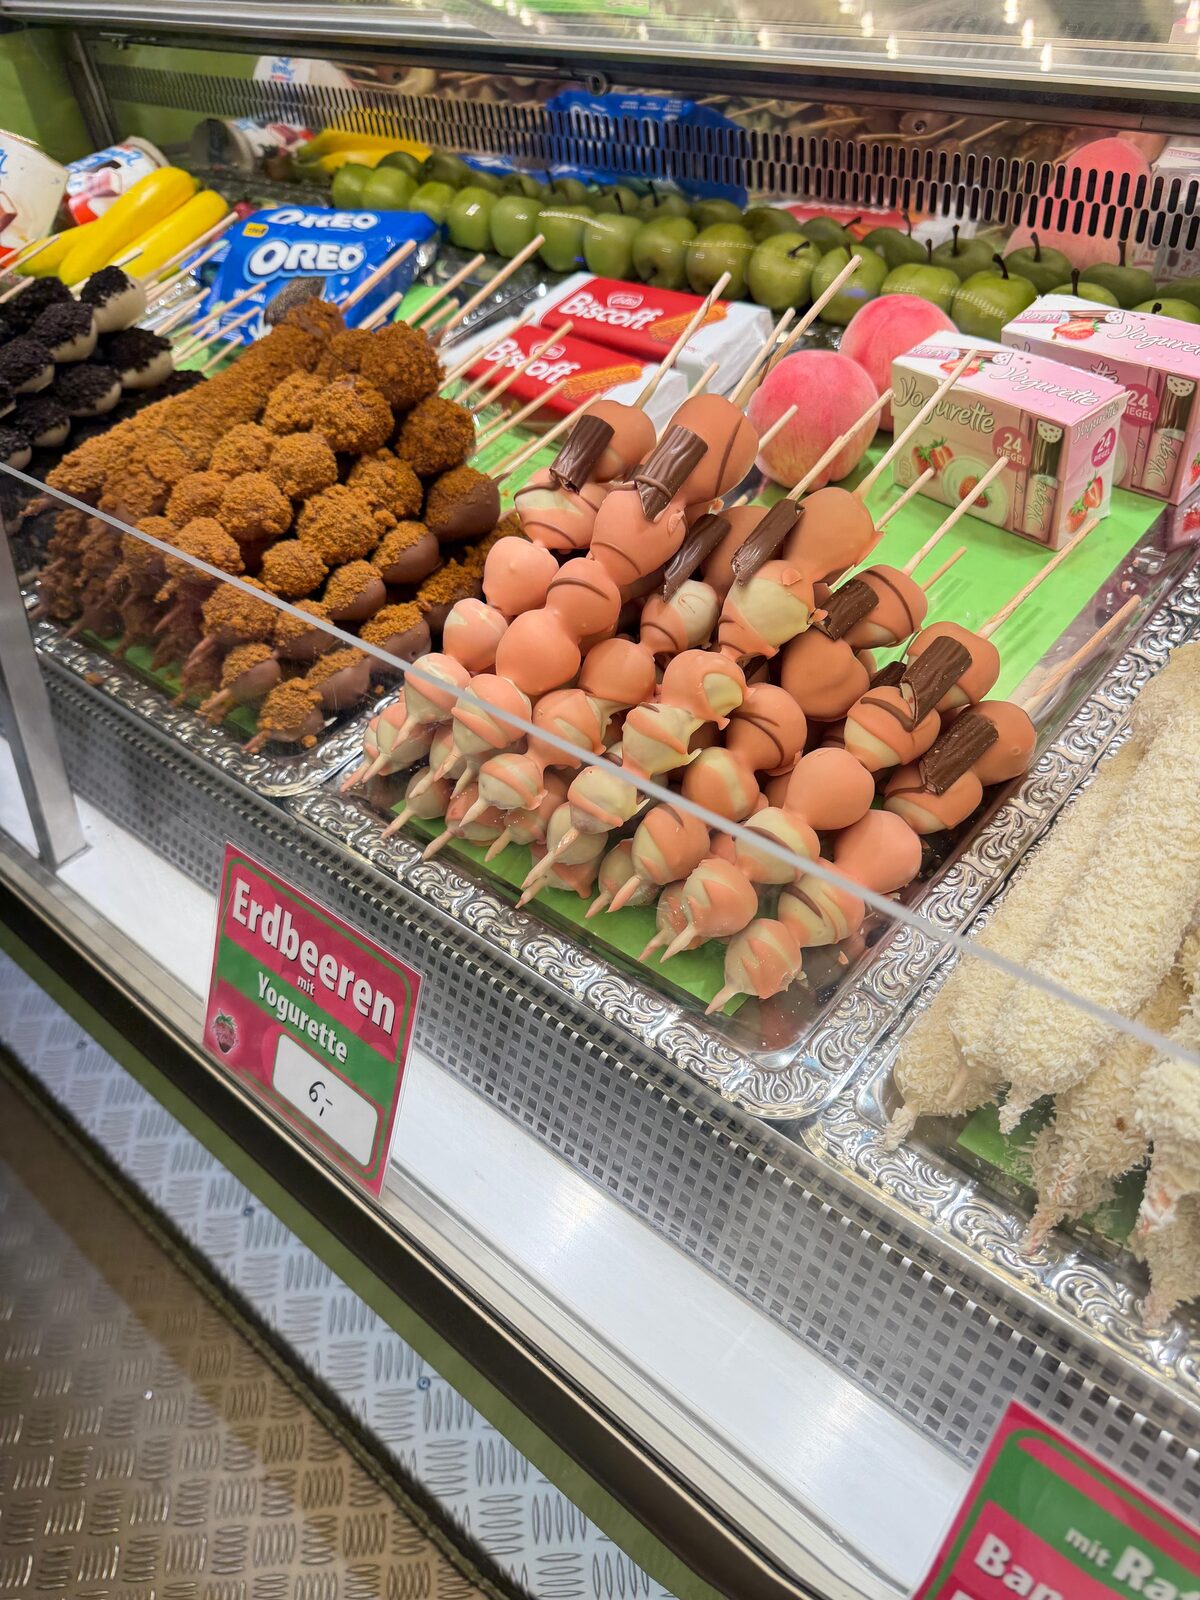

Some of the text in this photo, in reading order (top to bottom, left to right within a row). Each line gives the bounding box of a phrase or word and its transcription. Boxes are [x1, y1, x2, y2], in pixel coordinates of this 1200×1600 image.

[267, 208, 379, 231] OREO
[249, 239, 366, 276] OREO
[558, 291, 665, 331] Biscoff
[989, 366, 1101, 407] Yogurette
[1127, 390, 1149, 410] 24
[1126, 406, 1153, 421] IEGEL
[1003, 433, 1022, 453] 24
[1097, 432, 1112, 454] 24
[996, 446, 1027, 466] RIEGEL
[232, 877, 396, 1035] Erdbeeren
[297, 974, 316, 998] mit
[258, 971, 349, 1064] Yogurette
[1064, 1527, 1112, 1568] mit
